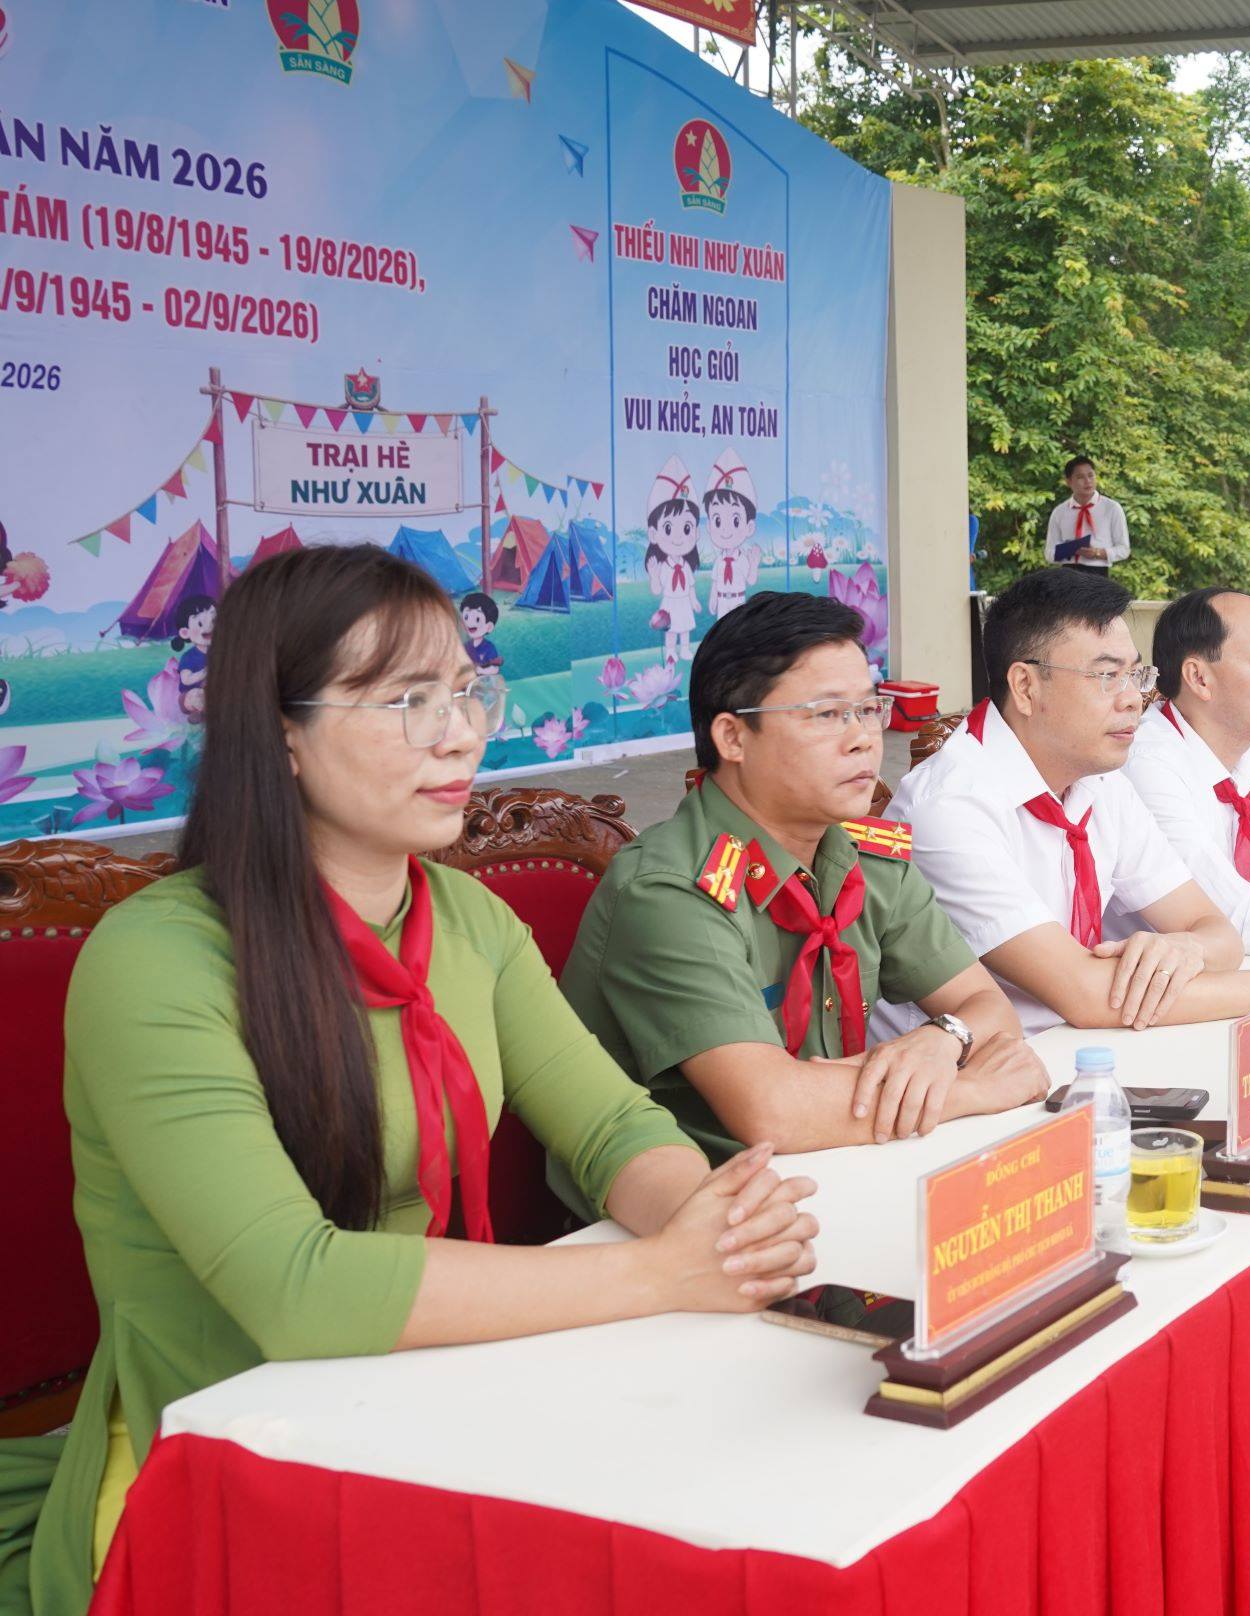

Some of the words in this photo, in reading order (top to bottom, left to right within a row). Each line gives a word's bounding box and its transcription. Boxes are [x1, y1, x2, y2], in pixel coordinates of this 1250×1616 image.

[60, 124, 160, 181] NĂM
[172, 148, 267, 199] 2026
[82, 204, 249, 265] (19/8/1945
[279, 234, 426, 292] 19/8/2026),
[614, 220, 664, 263] THIẾU
[670, 234, 699, 269] NHI
[704, 240, 739, 274] NHƯ
[743, 245, 785, 281] XUÂN
[0, 267, 131, 322] /9/1945
[164, 287, 319, 344] 02/9/2026)
[648, 283, 697, 324] CHĂM
[703, 294, 757, 330] NGOAN
[1, 361, 62, 391] 2026
[669, 346, 702, 384] HỌC
[707, 341, 739, 382] GIỎI
[624, 397, 651, 431] VUI
[658, 391, 706, 438] KHỎE,
[711, 404, 733, 436] AN
[739, 401, 778, 438] TOÀN
[306, 442, 368, 473] TRẠI
[377, 440, 410, 469] HÈ
[291, 478, 350, 504] NHƯ
[357, 476, 426, 504] XUÂN
[1004, 1197, 1033, 1237] THỊ
[1033, 1171, 1084, 1221] THANH
